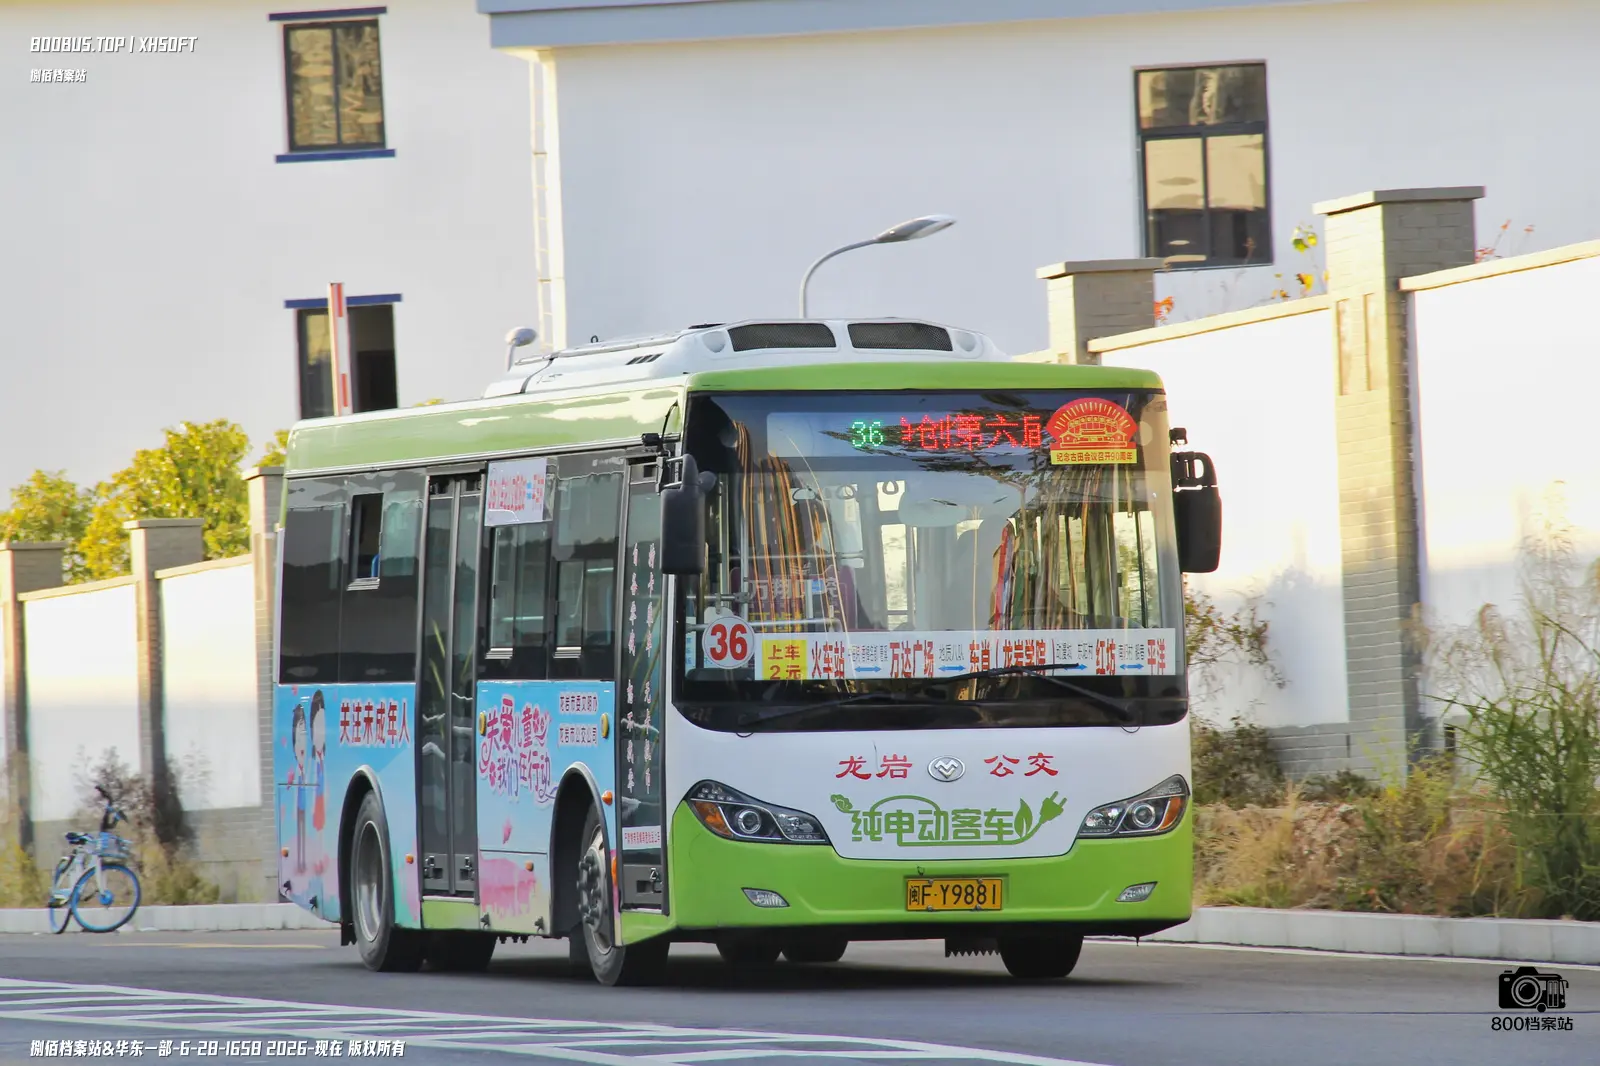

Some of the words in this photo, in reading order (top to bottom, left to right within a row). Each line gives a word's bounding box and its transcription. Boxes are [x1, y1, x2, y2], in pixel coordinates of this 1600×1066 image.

[851, 421, 884, 447] 36
[709, 623, 748, 661] 36
[767, 644, 800, 660] 上车
[769, 664, 800, 679] 2元
[811, 641, 845, 679] 火车站
[889, 640, 934, 678] 万达广场
[340, 701, 410, 745] 关注未成年人
[835, 753, 913, 780] 龙岩
[983, 752, 1059, 777] 公交
[851, 808, 1014, 845] 纯电动客车
